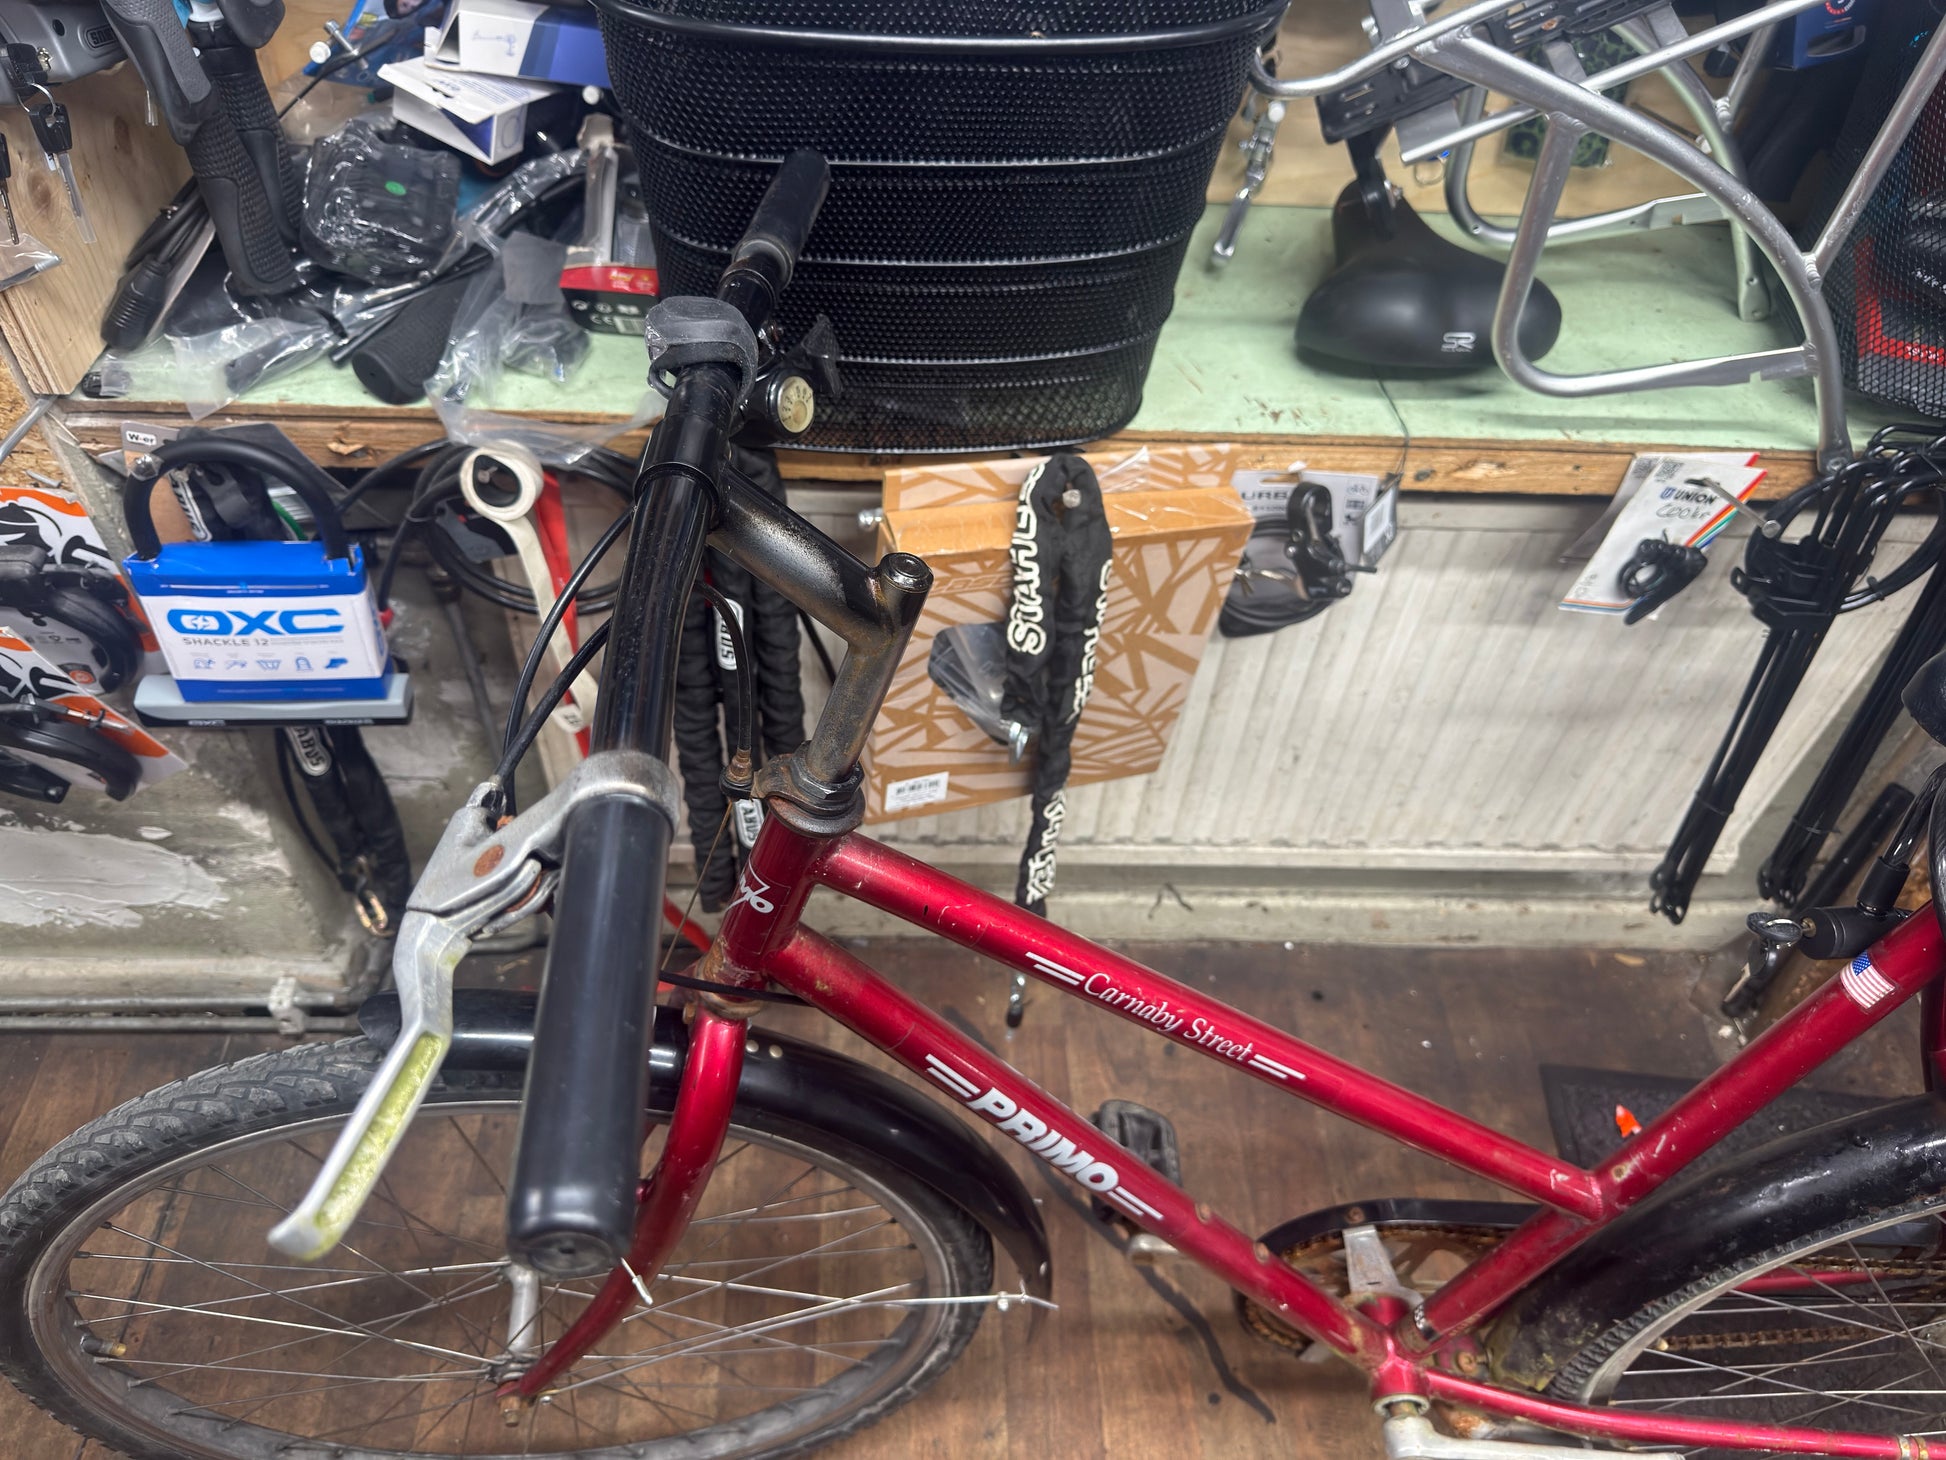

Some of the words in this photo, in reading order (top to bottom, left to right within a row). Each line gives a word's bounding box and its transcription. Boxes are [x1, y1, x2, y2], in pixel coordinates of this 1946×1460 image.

[1241, 491, 1288, 500] URB
[1673, 489, 1717, 504] UNION
[167, 608, 345, 636] OXC
[183, 636, 250, 647] SHACKLE
[254, 638, 269, 647] 12
[1084, 972, 1184, 1032] Carnaby
[1183, 1017, 1253, 1062] Street
[967, 1086, 1119, 1192] PRIMO
